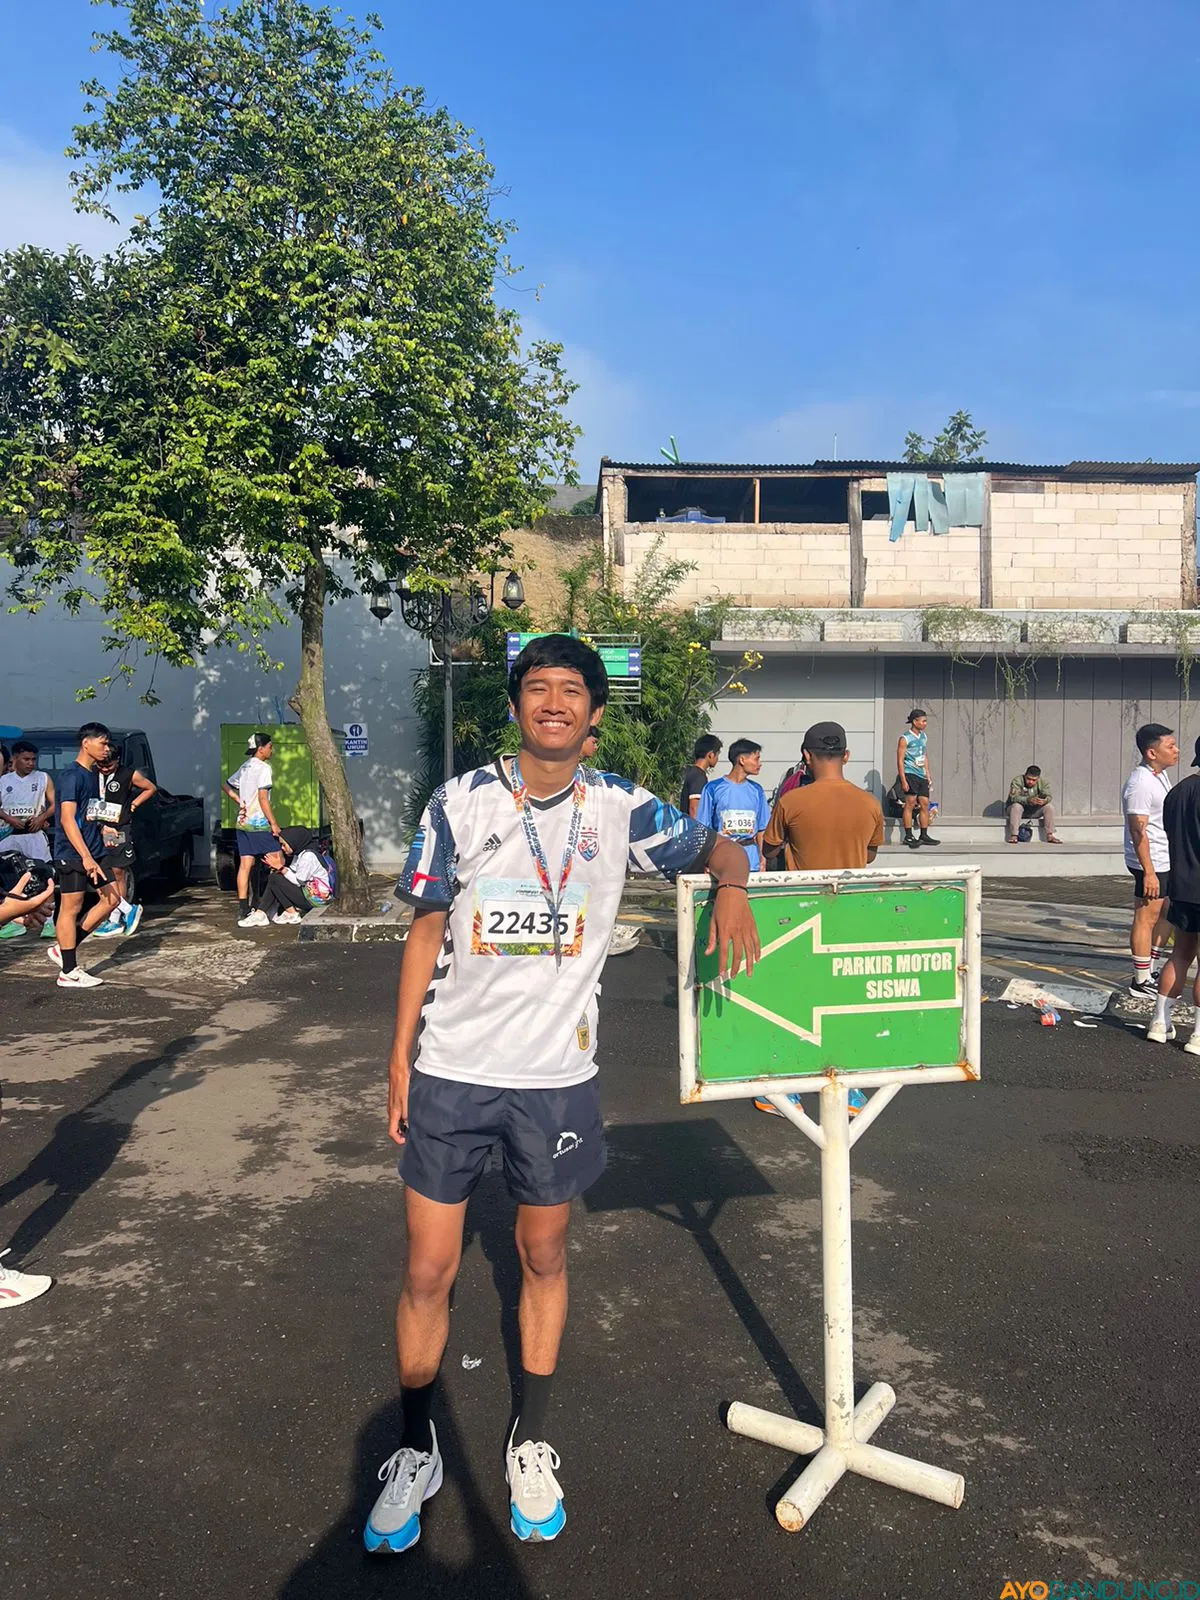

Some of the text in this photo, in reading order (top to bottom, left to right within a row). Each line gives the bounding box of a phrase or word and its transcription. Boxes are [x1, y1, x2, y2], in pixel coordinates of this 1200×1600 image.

[487, 910, 569, 936] 22435
[832, 952, 953, 977] PARKIR MOTOR
[866, 978, 921, 999] SISWA
